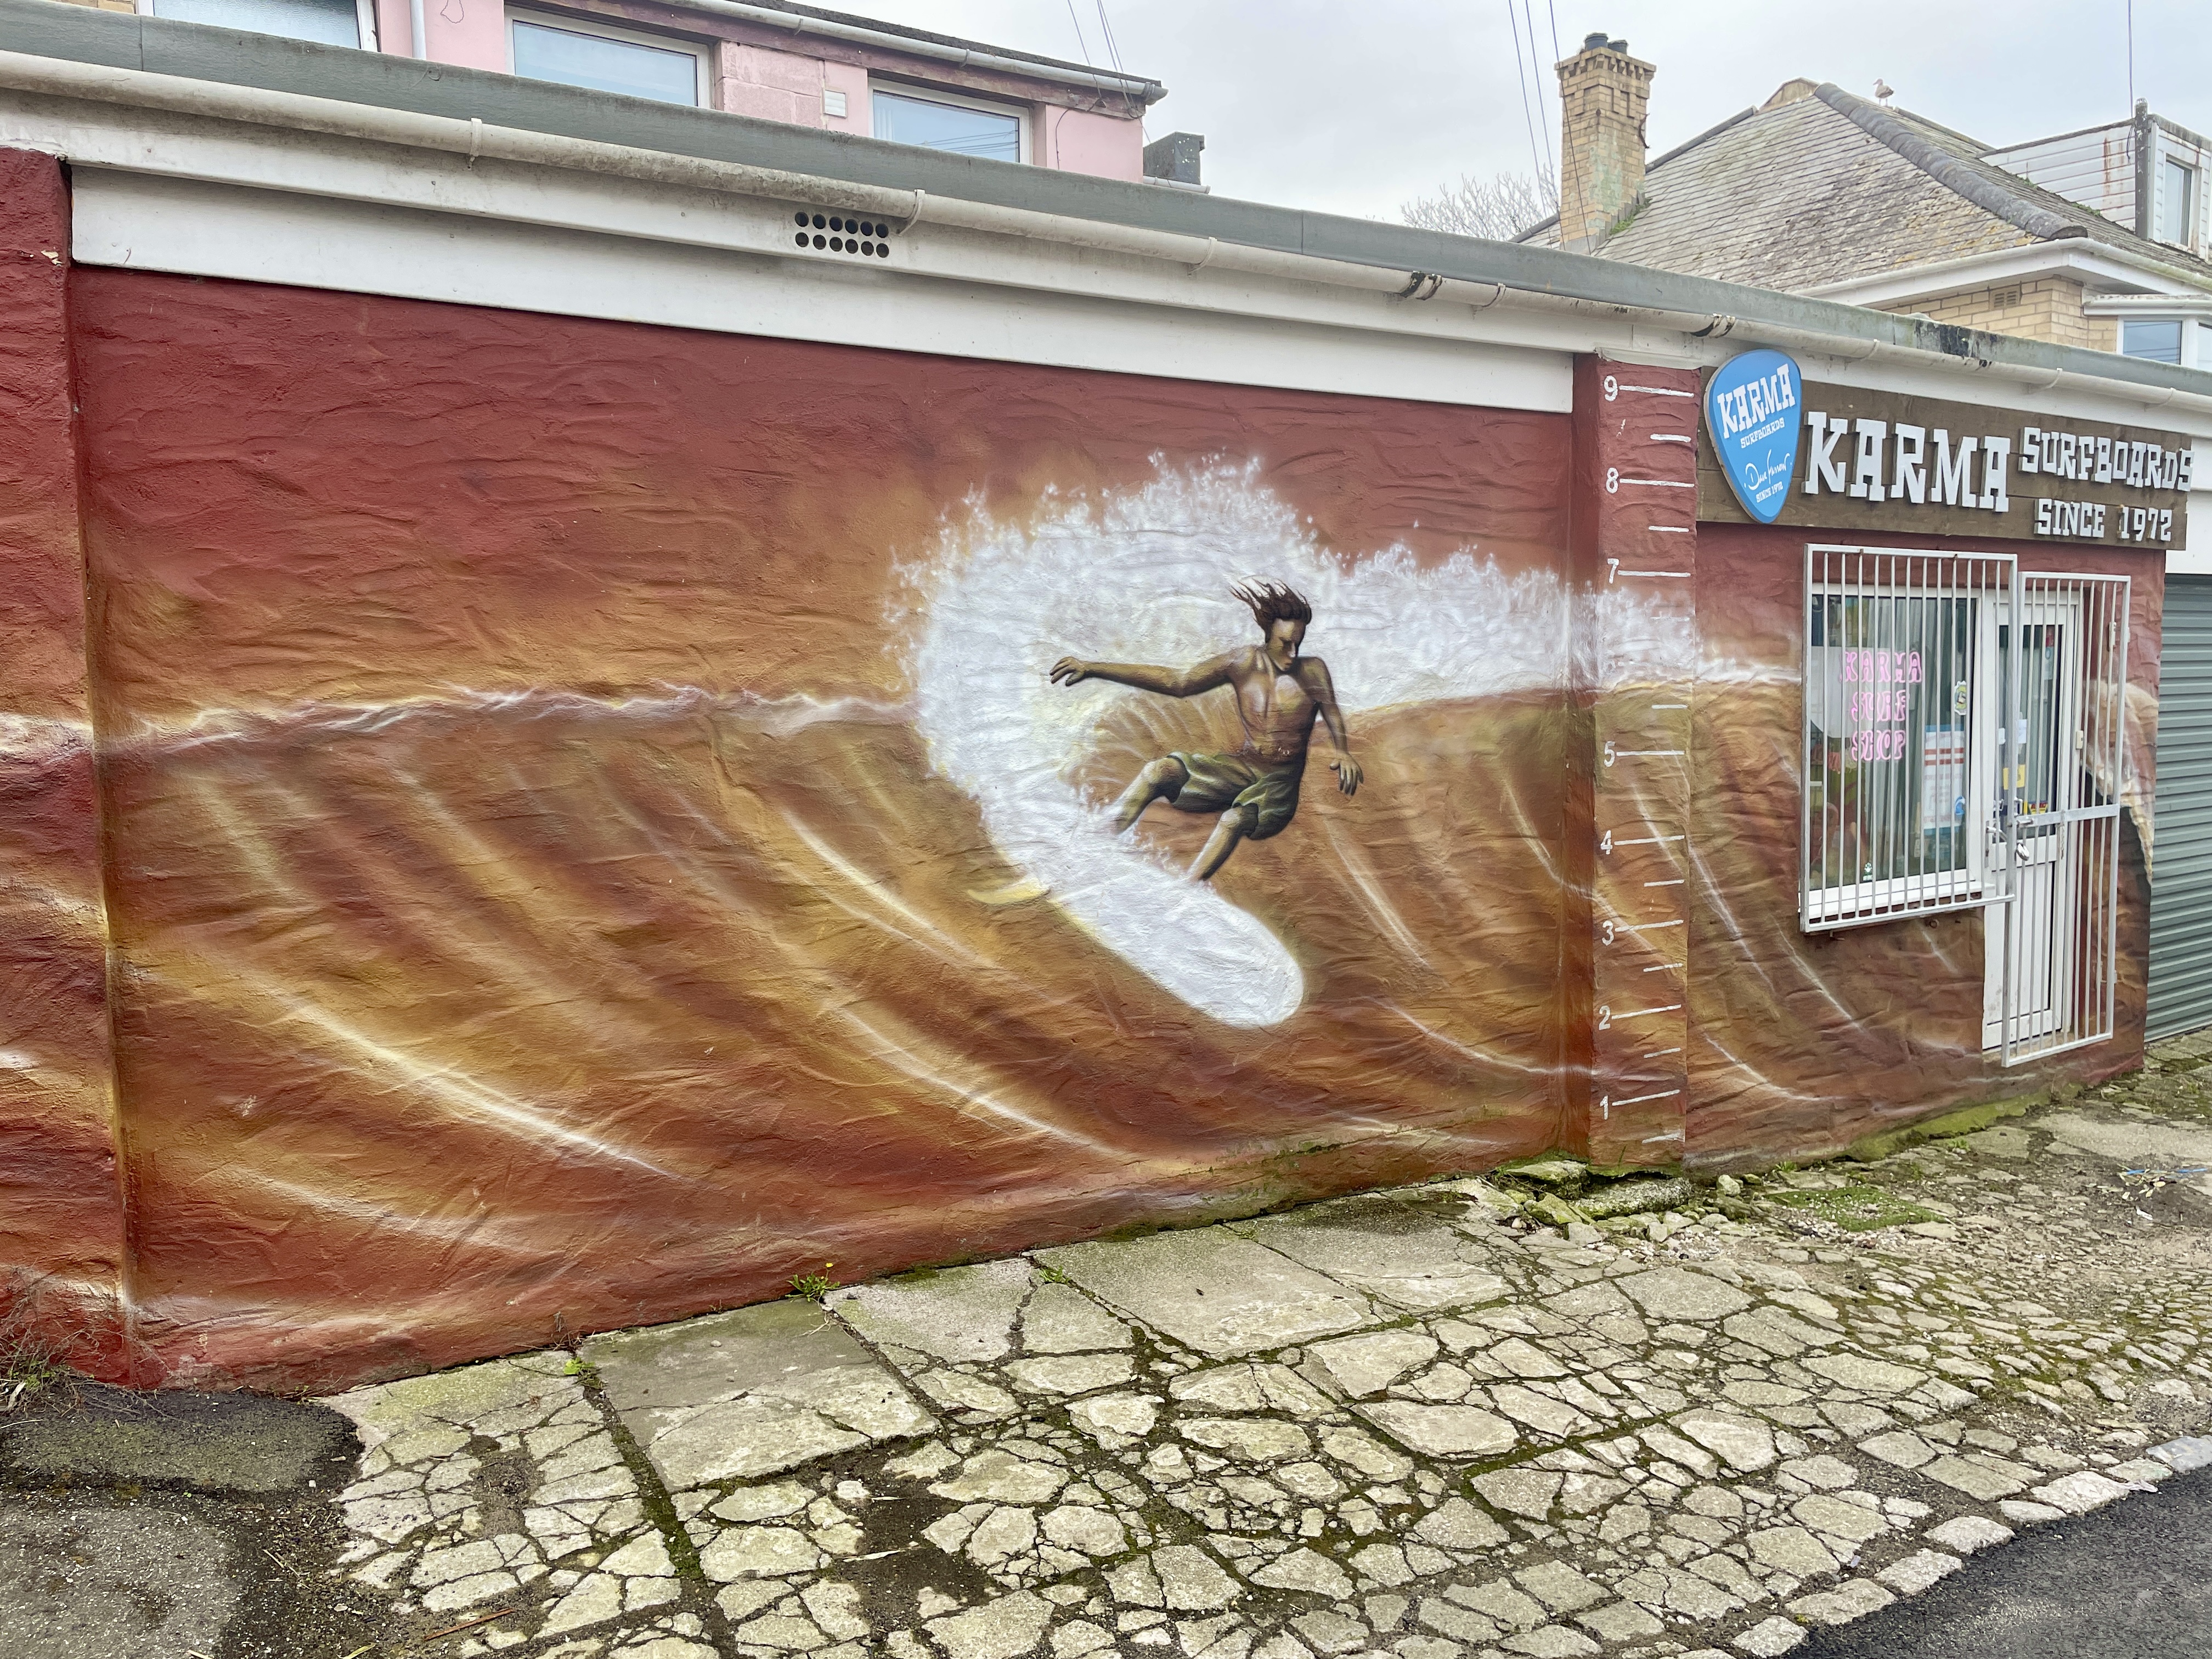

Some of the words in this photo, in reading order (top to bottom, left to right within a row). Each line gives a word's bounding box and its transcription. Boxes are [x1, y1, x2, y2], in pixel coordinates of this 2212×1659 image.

[1604, 375, 1618, 402] 9
[1717, 363, 1796, 439] KARMA
[1740, 417, 1785, 449] SURFBOARDS
[1803, 411, 2011, 512] KARMA
[2020, 426, 2194, 492] SURFBOARDS
[1606, 467, 1620, 494] 8
[1756, 487, 1772, 503] SINCE
[1771, 481, 1784, 495] 1972
[2035, 498, 2106, 538] SINCE
[2119, 506, 2172, 541] 1972
[1606, 558, 1620, 584] 7
[1840, 650, 1922, 683] KARMA
[1603, 741, 1616, 767] 5
[1600, 830, 1613, 855] 4
[1601, 921, 1614, 946] 3
[1599, 1006, 1611, 1030] 2
[1600, 1096, 1609, 1120] 1
